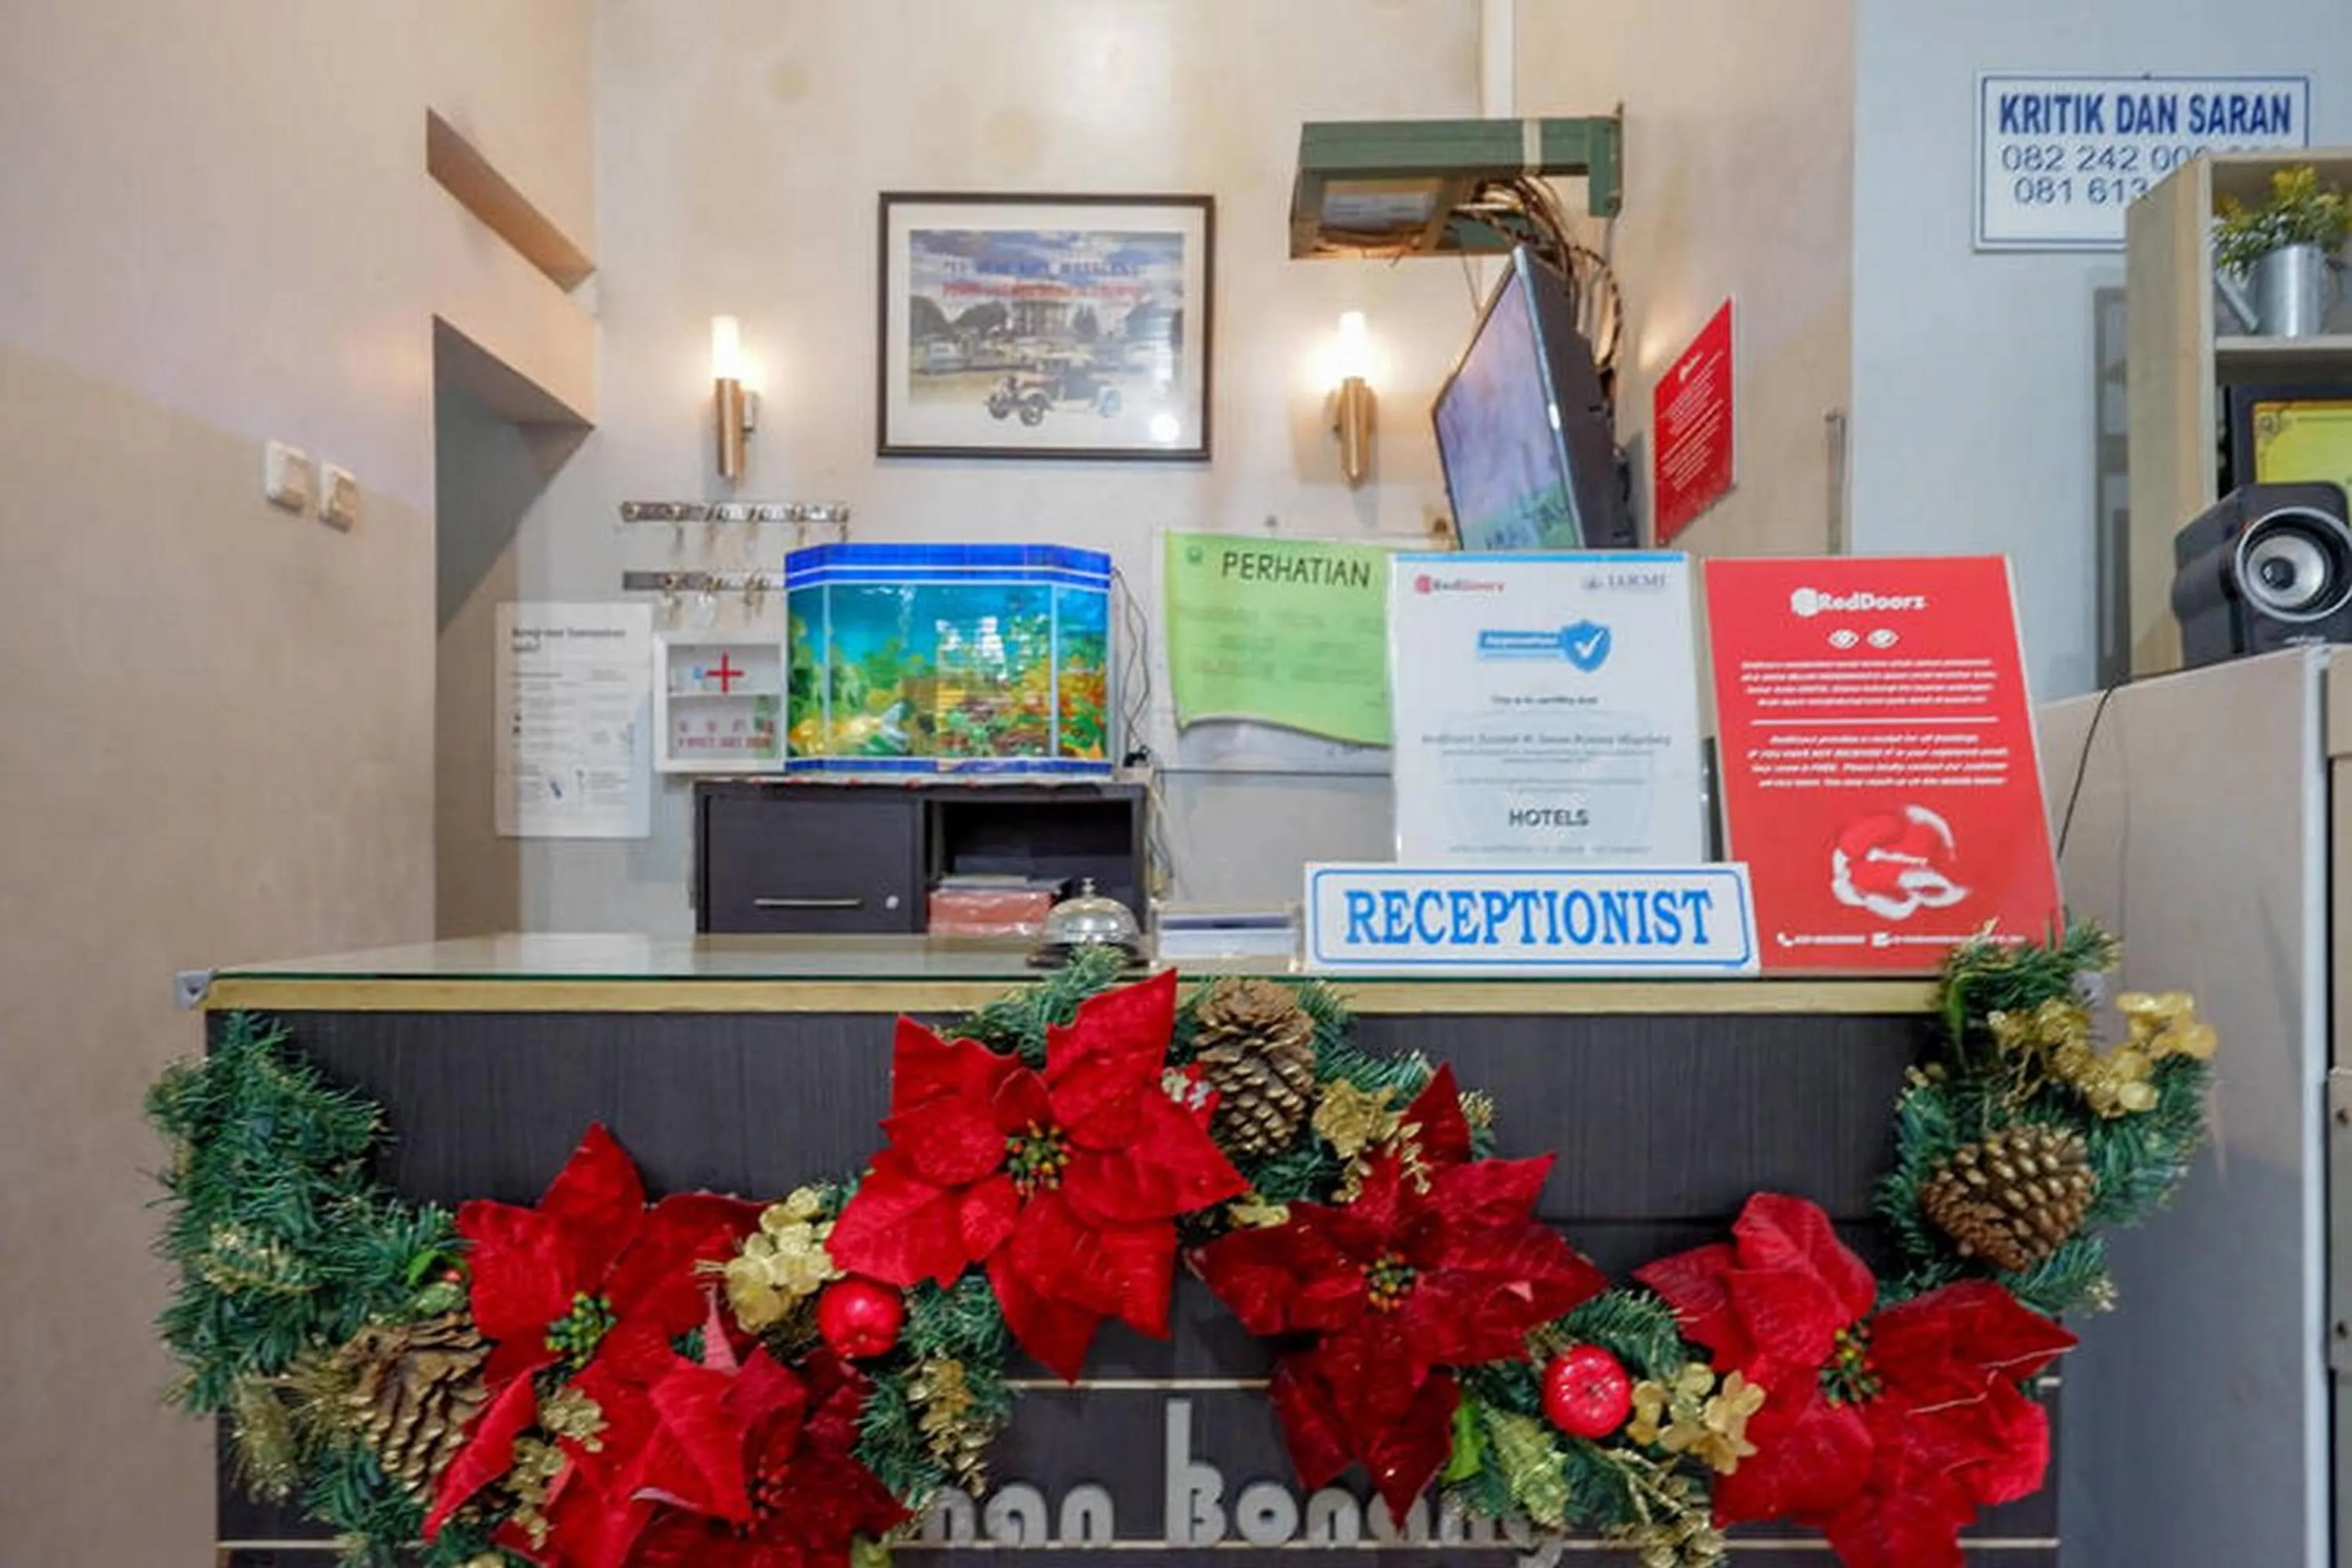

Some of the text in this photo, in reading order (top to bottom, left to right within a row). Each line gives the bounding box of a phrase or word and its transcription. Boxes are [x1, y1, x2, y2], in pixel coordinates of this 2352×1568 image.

[1999, 93, 2292, 134] KRITIK DAN SARAN
[2001, 145, 2063, 172] 082
[2076, 145, 2140, 172] 242
[2014, 176, 2073, 205] 081
[1221, 551, 1371, 589] PERHATIAN
[1817, 591, 1928, 611] RedDoorz
[1508, 808, 1590, 827] HOTELS
[1344, 889, 1714, 946] RECEPTIONIST
